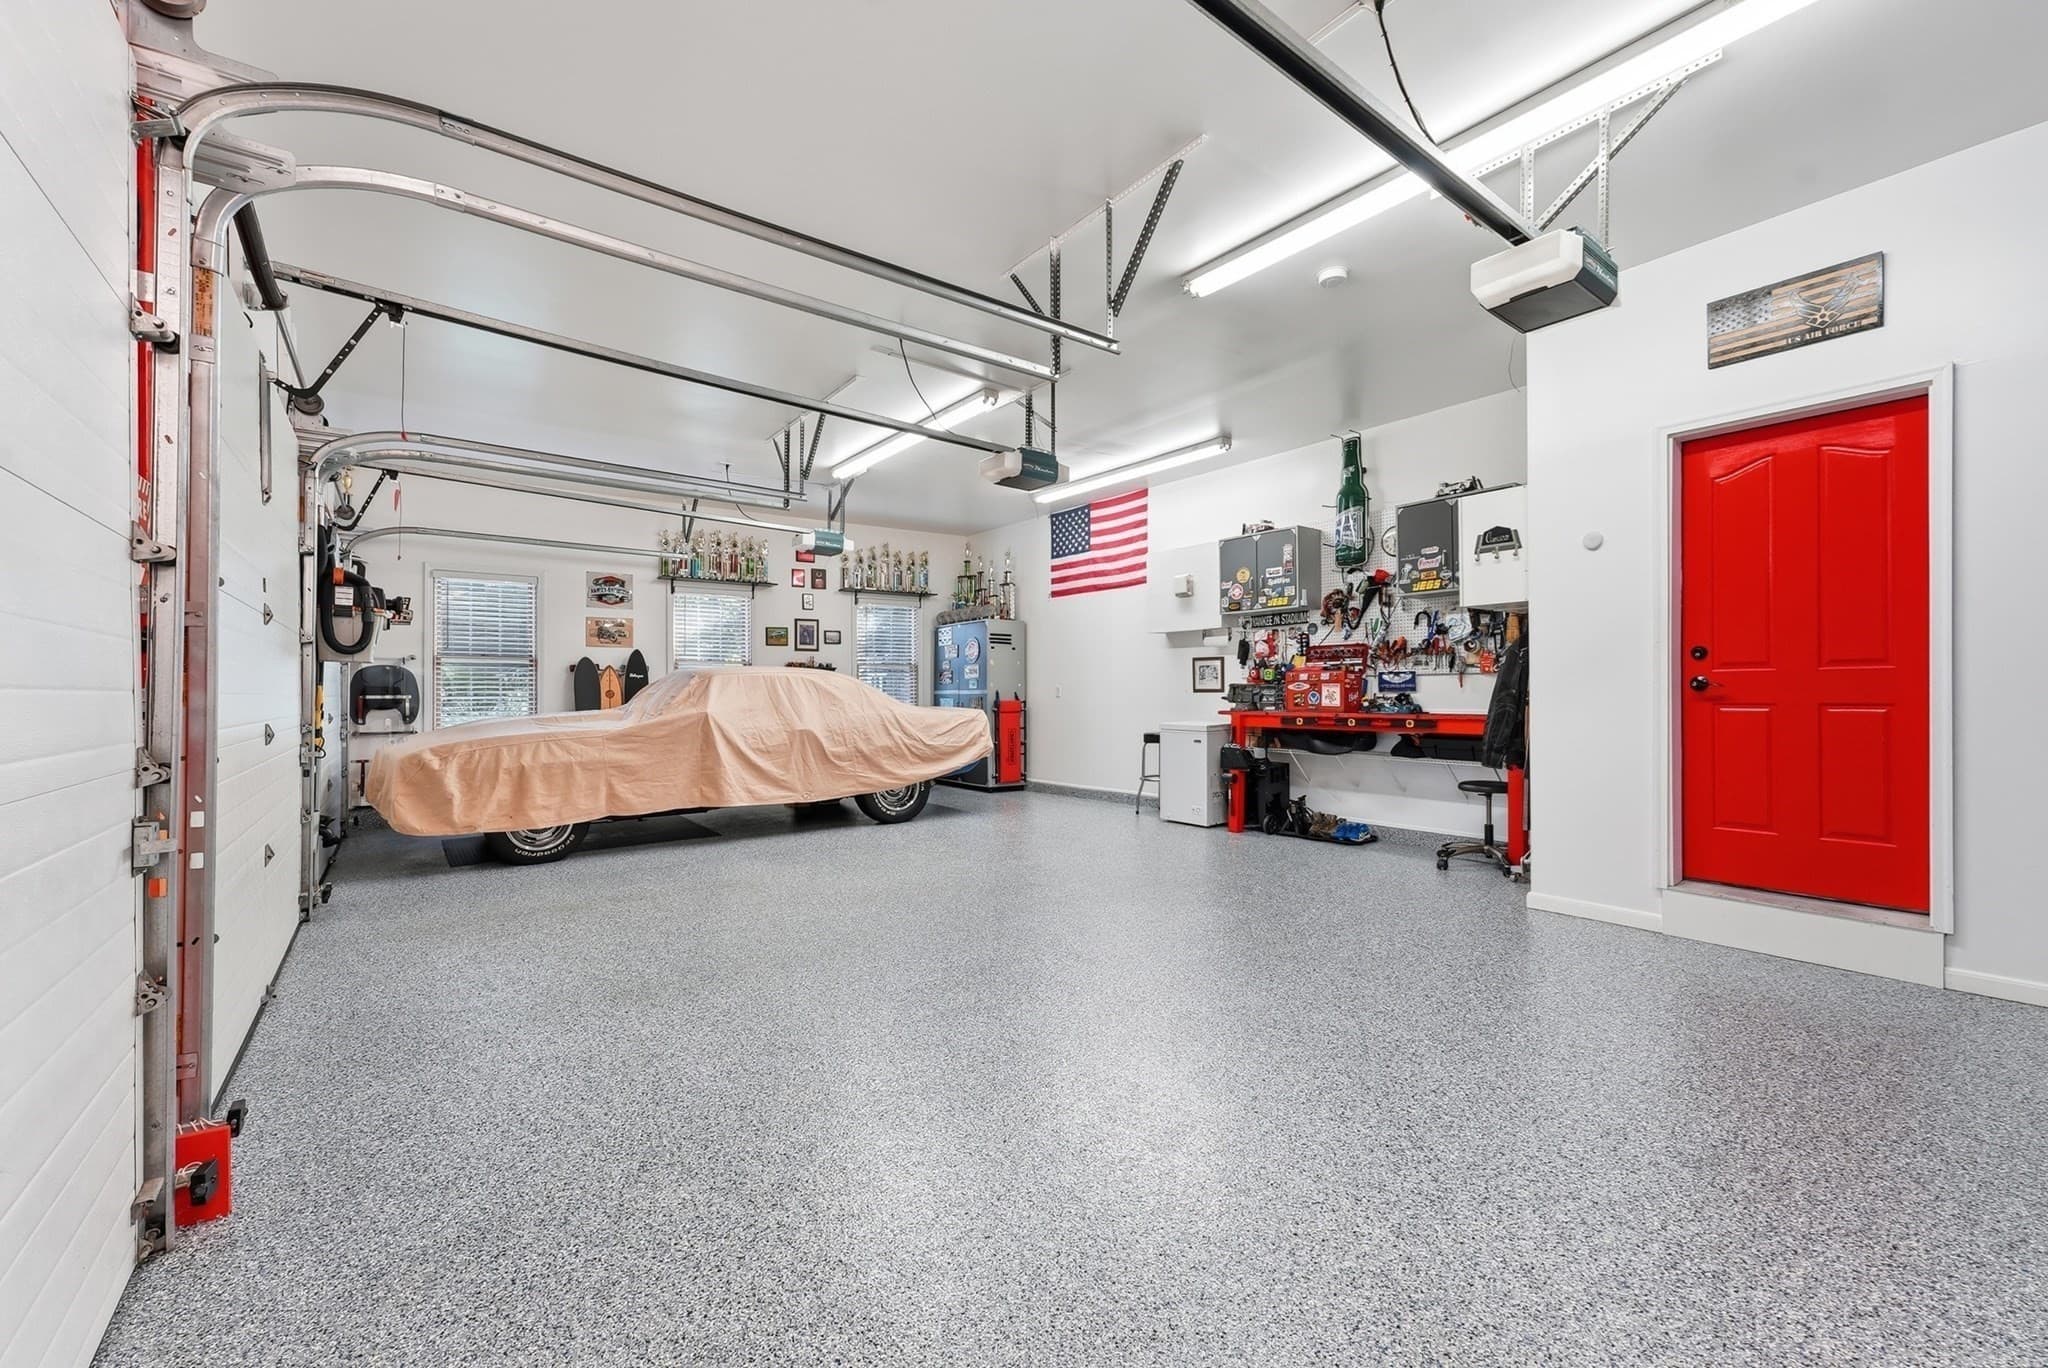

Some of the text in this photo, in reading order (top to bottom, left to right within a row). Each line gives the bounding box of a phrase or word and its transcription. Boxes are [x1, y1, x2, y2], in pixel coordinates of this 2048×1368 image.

[1804, 330, 1822, 340] AIR
[1825, 321, 1862, 335] FORCE
[1412, 579, 1441, 592] JEGS
